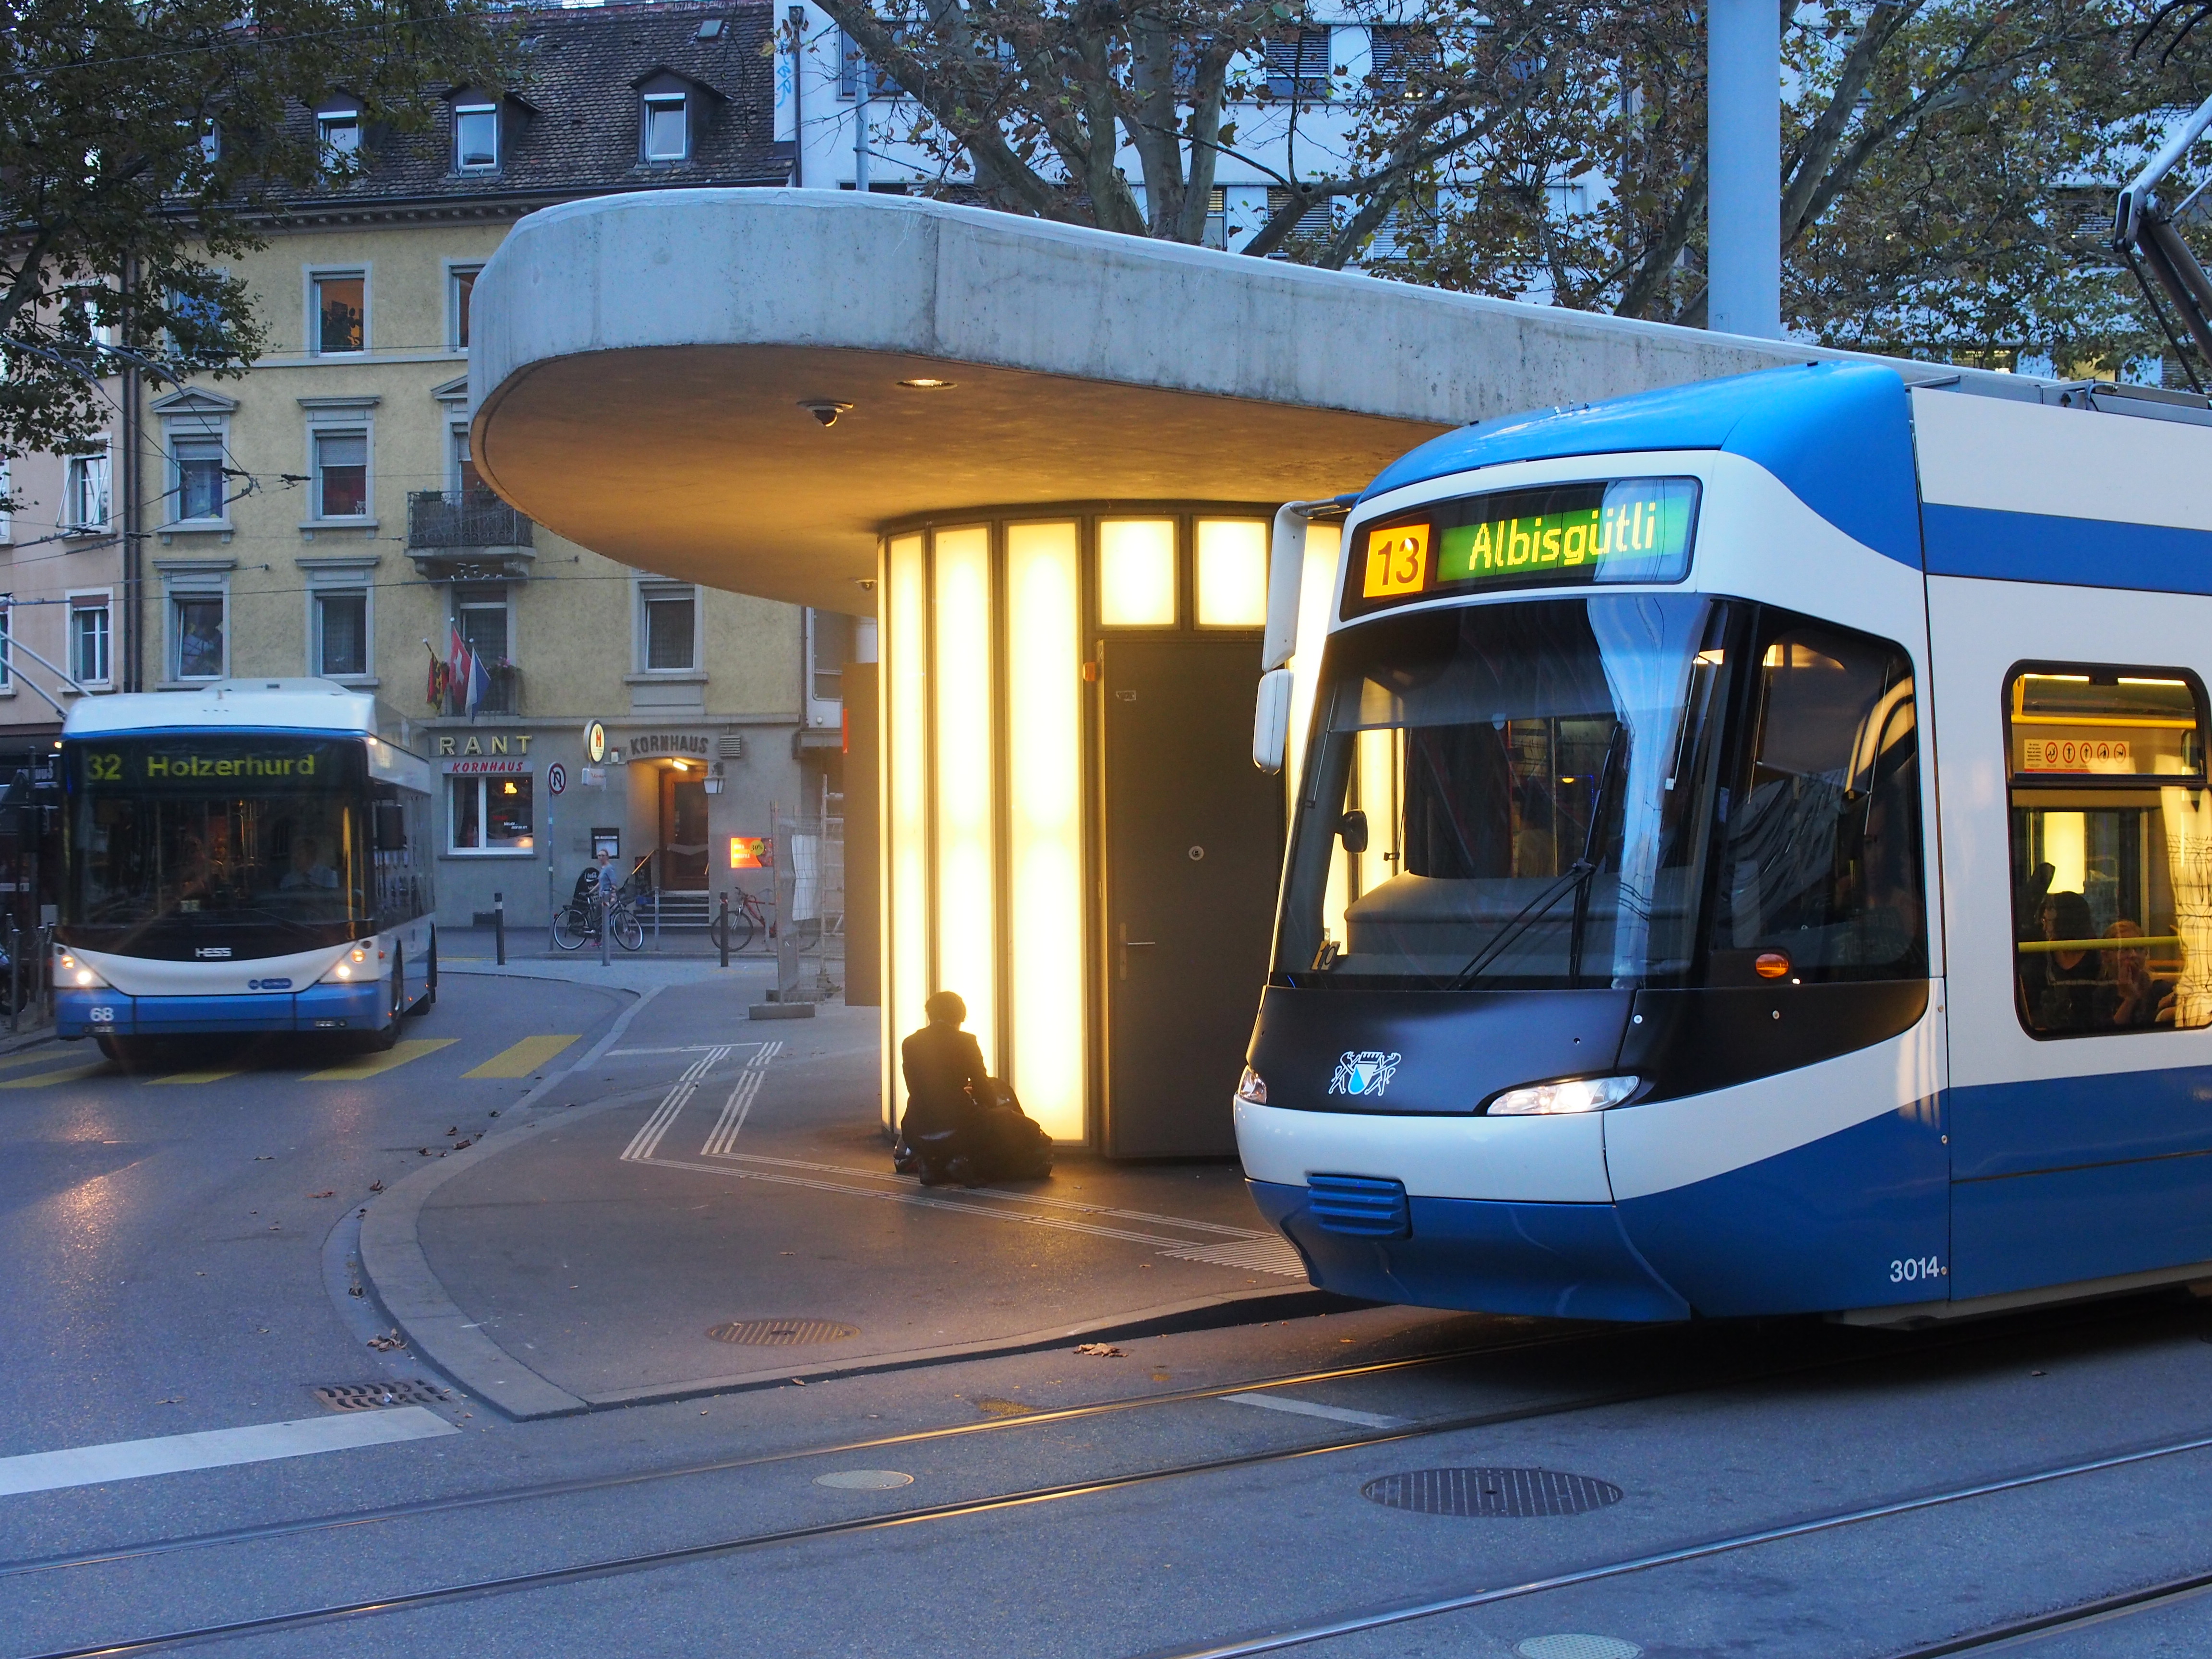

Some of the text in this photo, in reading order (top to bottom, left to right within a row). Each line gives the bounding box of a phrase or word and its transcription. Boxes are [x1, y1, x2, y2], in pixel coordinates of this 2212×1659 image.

[1377, 502, 1656, 586] 13 Albisgütli
[440, 735, 532, 755] RANT
[630, 735, 709, 755] KORNHAUS
[88, 754, 315, 780] 32 Holzerhurd
[452, 762, 523, 773] KORNHAUS
[195, 947, 232, 958] HESS
[90, 1007, 114, 1022] 68
[1890, 1255, 1940, 1283] 3014
